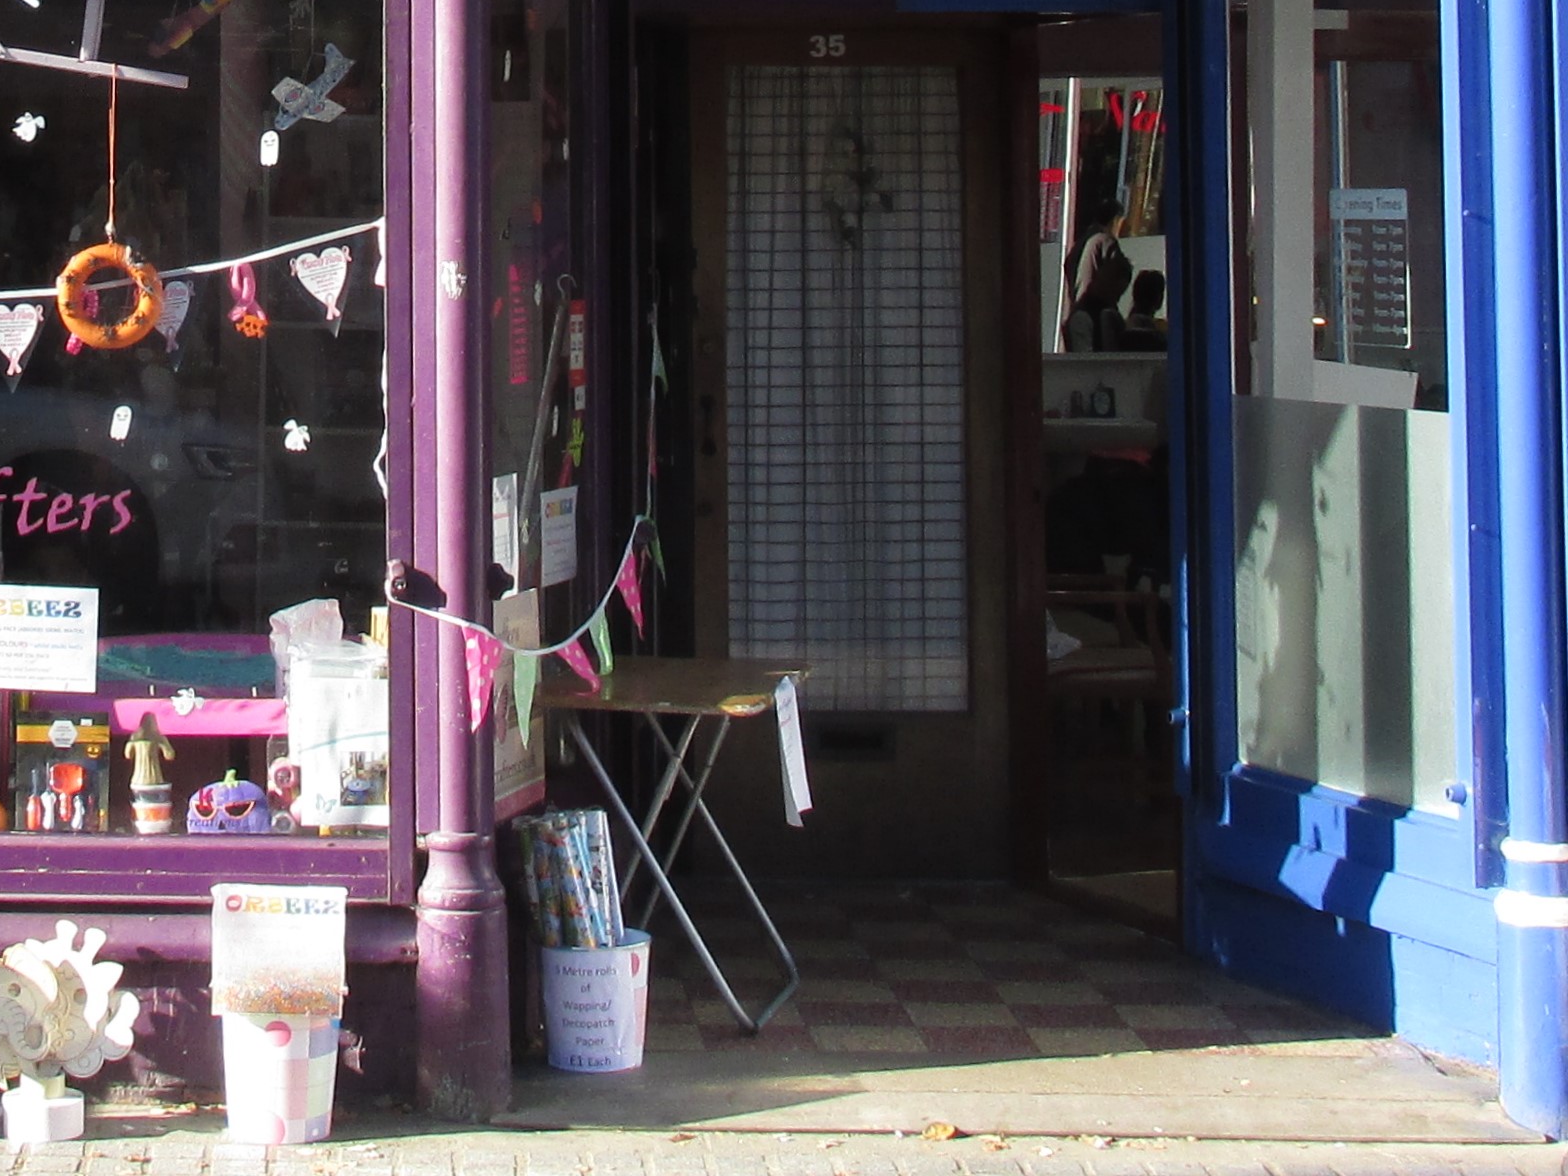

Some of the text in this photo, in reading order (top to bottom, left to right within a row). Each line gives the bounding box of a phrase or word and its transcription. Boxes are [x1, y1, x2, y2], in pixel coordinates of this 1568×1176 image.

[809, 34, 847, 58] 35
[1376, 196, 1403, 212] Times
[225, 893, 341, 916] ORBEEZ
[563, 965, 593, 976] Metre
[595, 964, 618, 976] rolls
[580, 983, 592, 994] of
[561, 1017, 616, 1030] Decopatch
[575, 1036, 606, 1048] Paper
[569, 1055, 613, 1068] £1 Each
